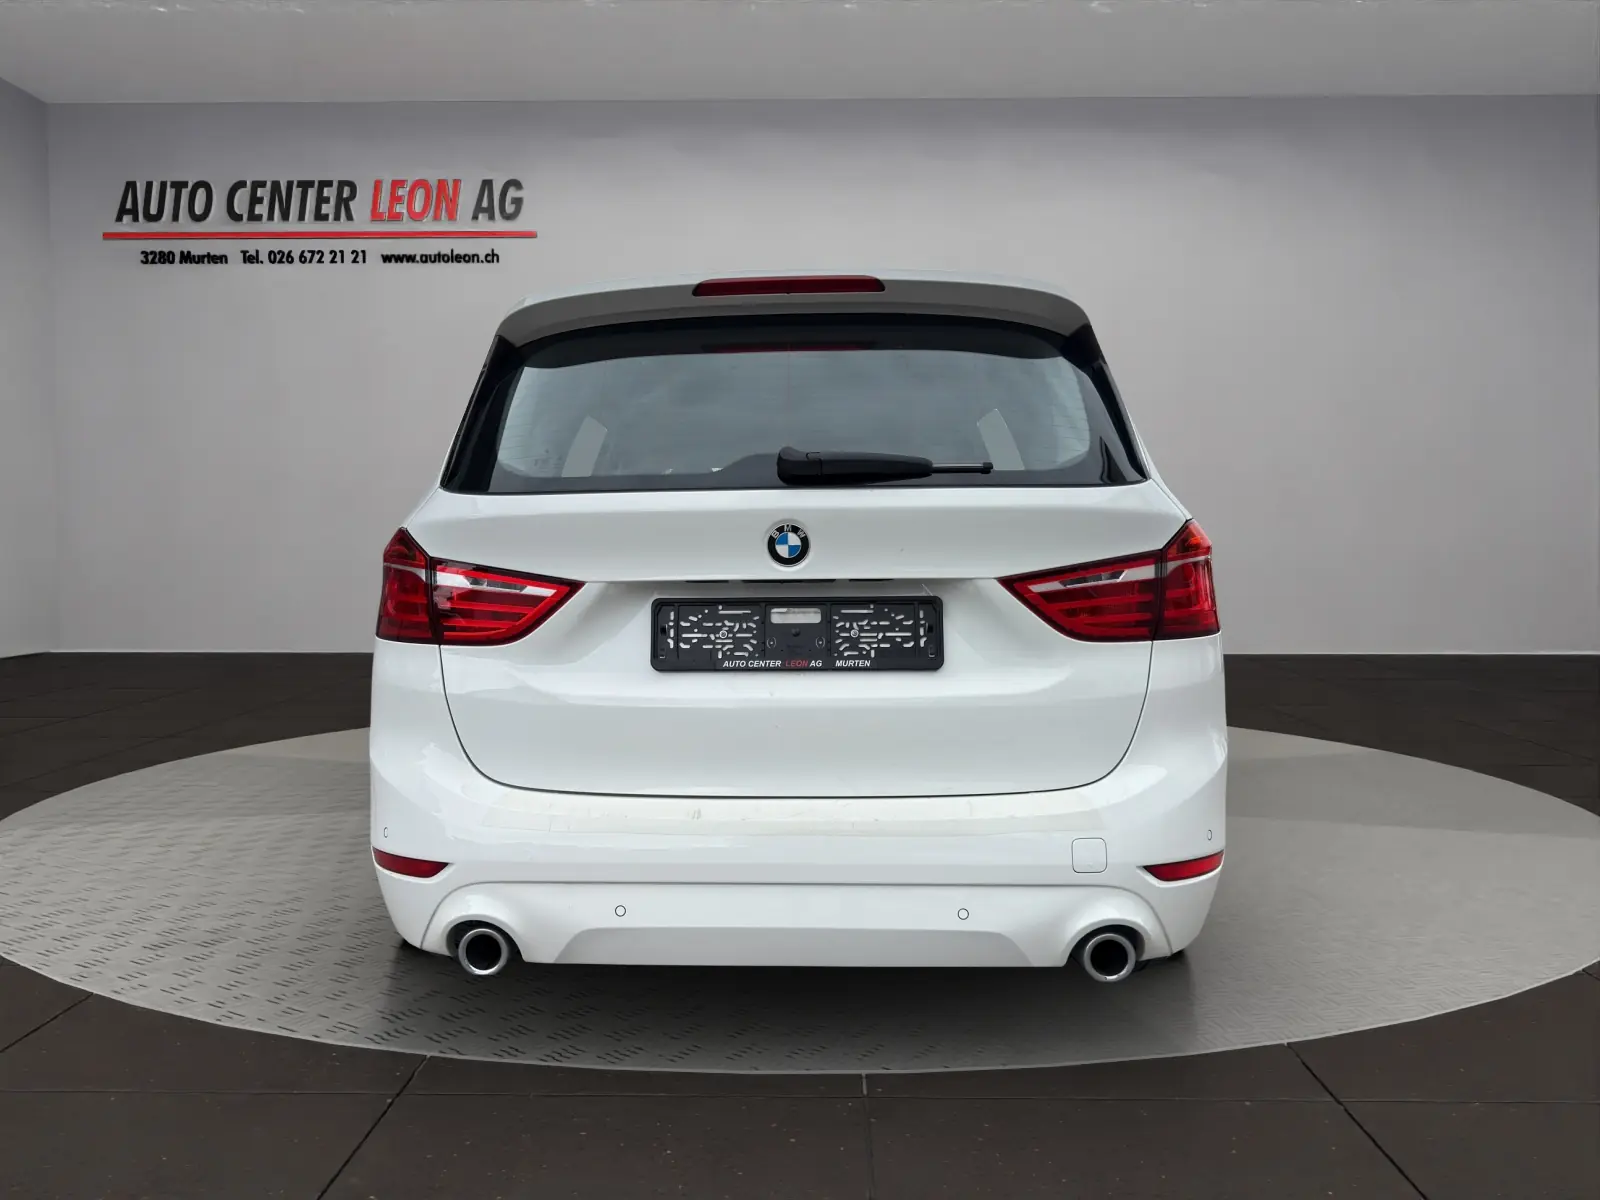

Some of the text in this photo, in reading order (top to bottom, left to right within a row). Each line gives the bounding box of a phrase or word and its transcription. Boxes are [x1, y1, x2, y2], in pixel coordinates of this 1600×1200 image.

[115, 179, 524, 222] AUTO CENTER LEON AG
[140, 248, 500, 265] 3280 Murten Tel. 026 672 21 21 www.autoleon.ch
[770, 523, 807, 540] BMW
[722, 659, 871, 668] AUTO CENTER LEON AG MURTEN
